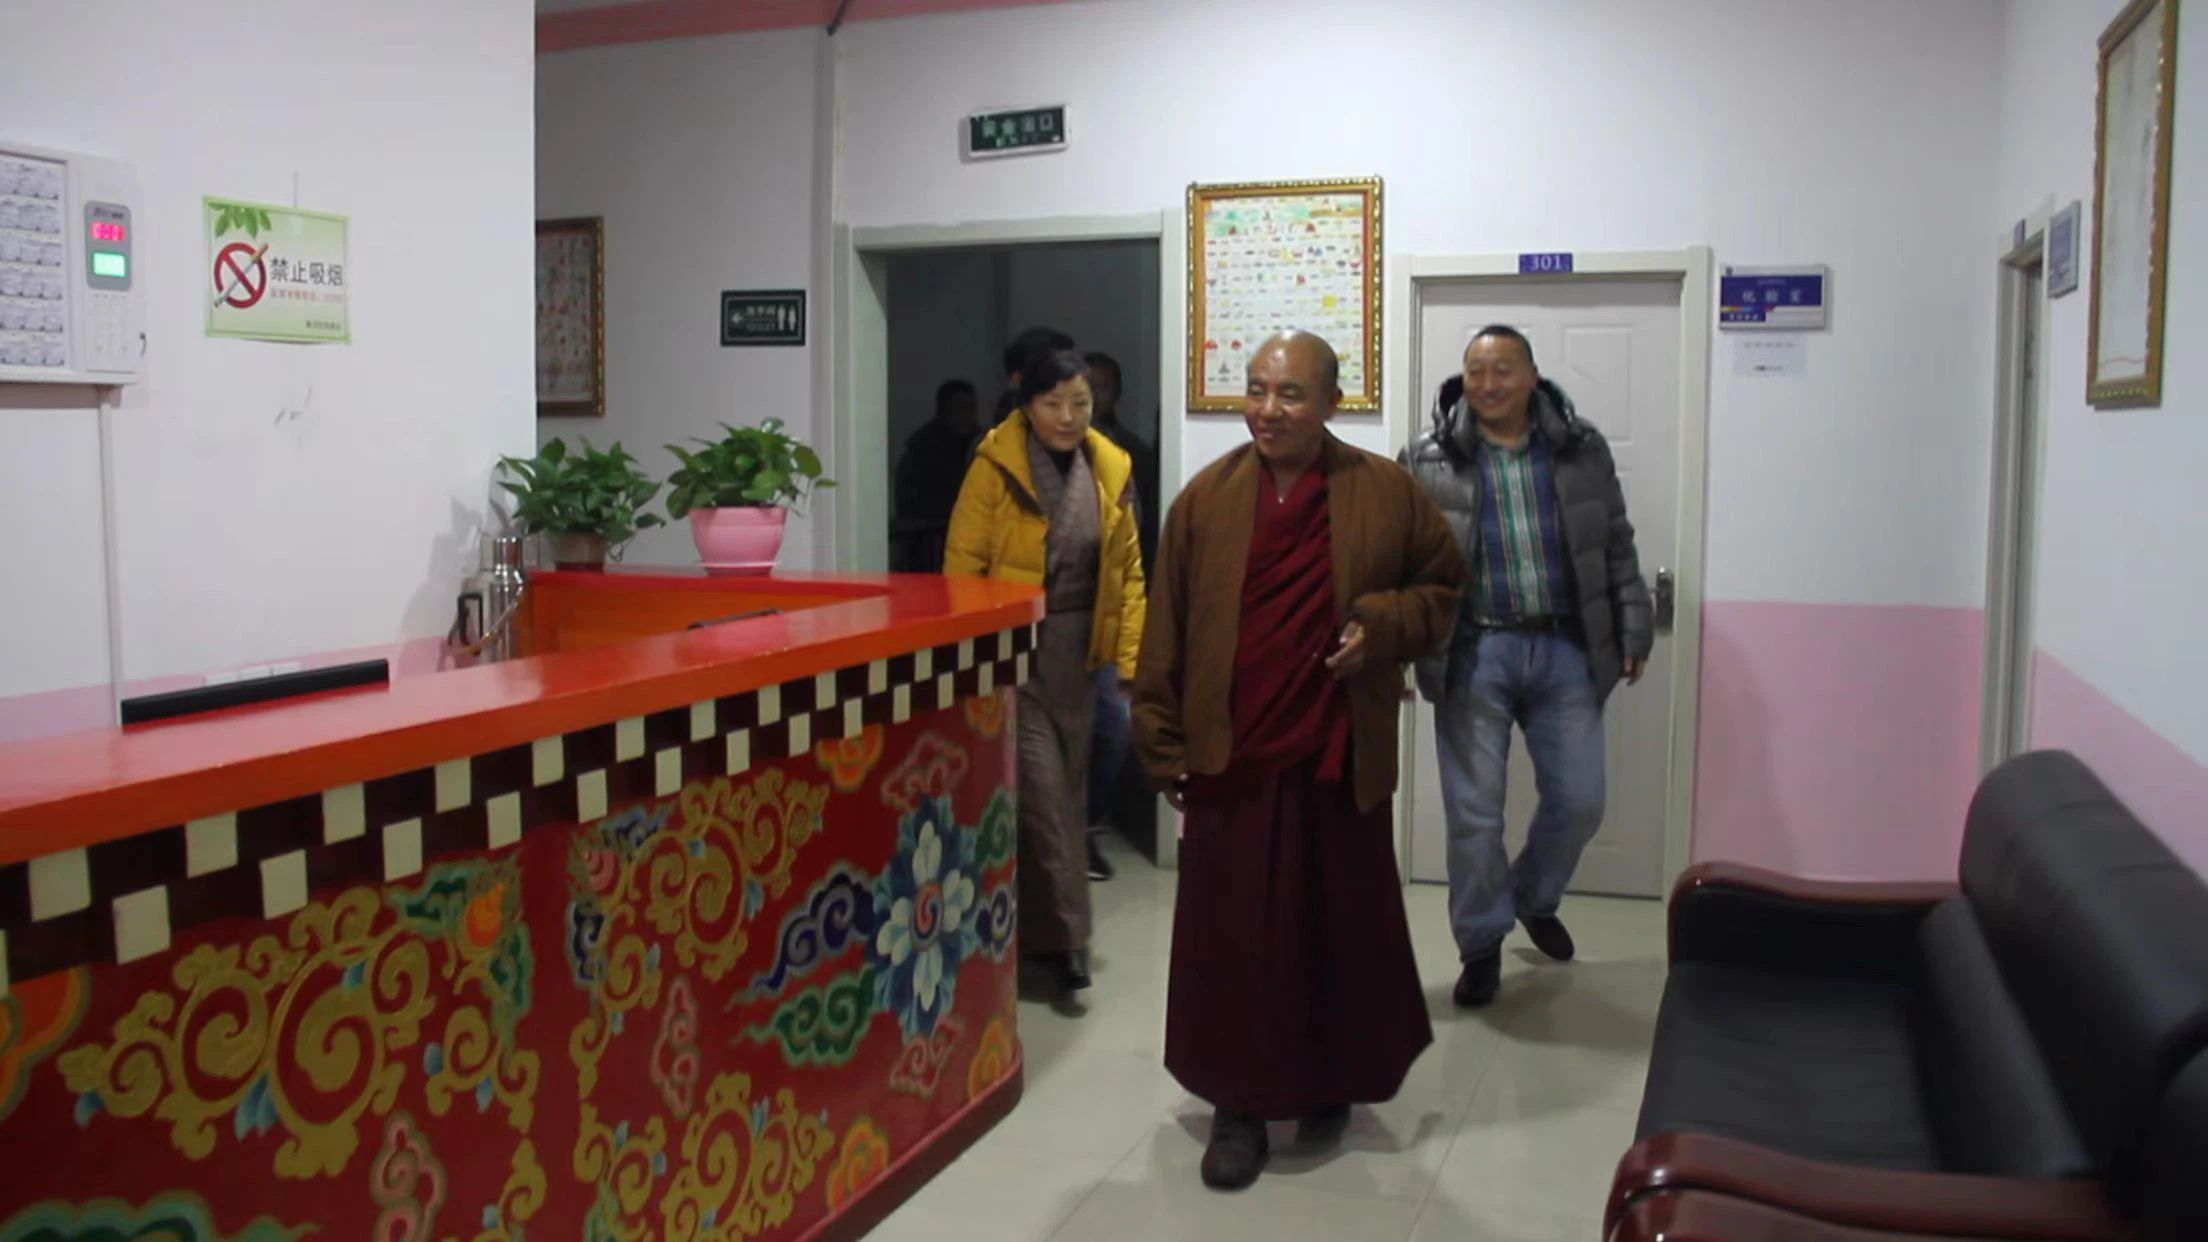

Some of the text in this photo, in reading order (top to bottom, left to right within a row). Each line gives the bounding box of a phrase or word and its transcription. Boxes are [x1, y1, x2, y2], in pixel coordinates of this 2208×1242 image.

[271, 256, 343, 287] 禁止吸烟
[1530, 254, 1561, 271] 301
